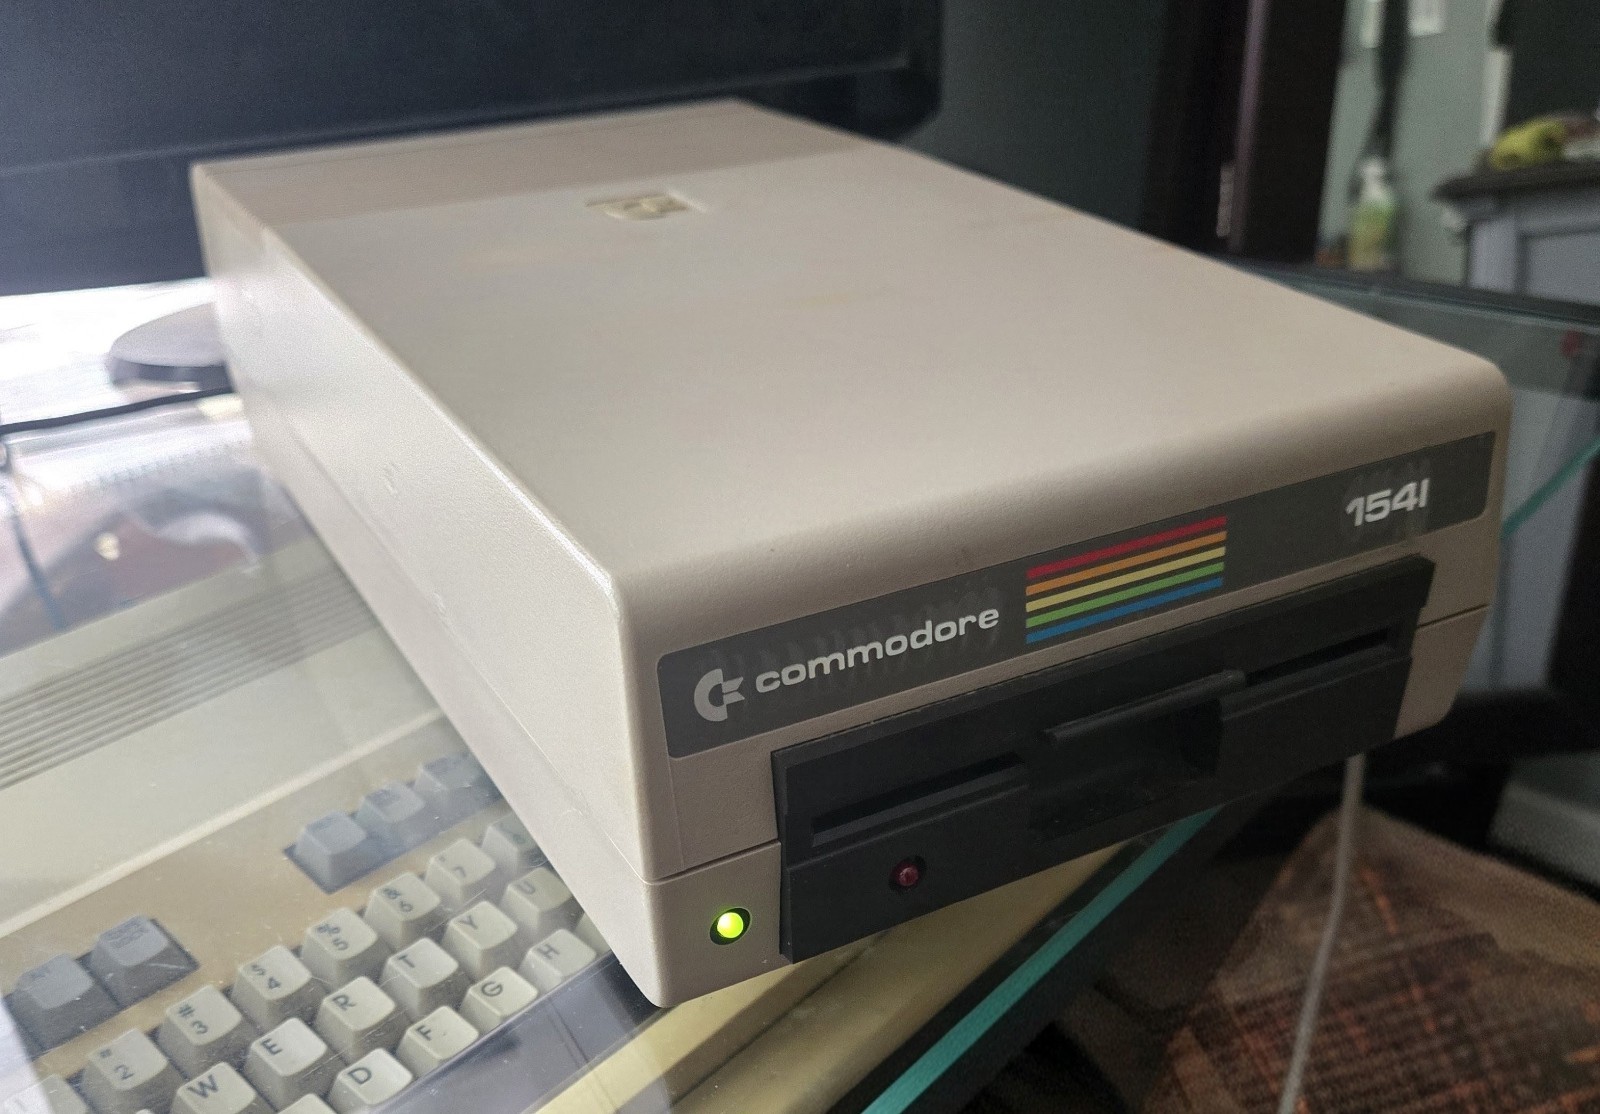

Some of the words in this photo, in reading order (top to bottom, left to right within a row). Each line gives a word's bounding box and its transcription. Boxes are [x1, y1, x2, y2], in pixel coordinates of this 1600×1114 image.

[1345, 478, 1430, 527] 1541
[755, 608, 1000, 693] commodore
[452, 865, 467, 878] 7
[517, 880, 536, 896] U
[400, 900, 414, 912] 6
[459, 915, 479, 930] Y
[331, 937, 349, 951] 5
[537, 943, 561, 960] H
[398, 954, 416, 969] T
[268, 976, 281, 990] 4
[481, 981, 504, 998] G
[331, 993, 356, 1011] R
[178, 1003, 196, 1018] #
[191, 1019, 209, 1035] 3
[416, 1025, 433, 1041] F
[260, 1037, 283, 1056] E
[113, 1064, 135, 1081] 2
[348, 1066, 372, 1085] D
[187, 1074, 220, 1099] W
